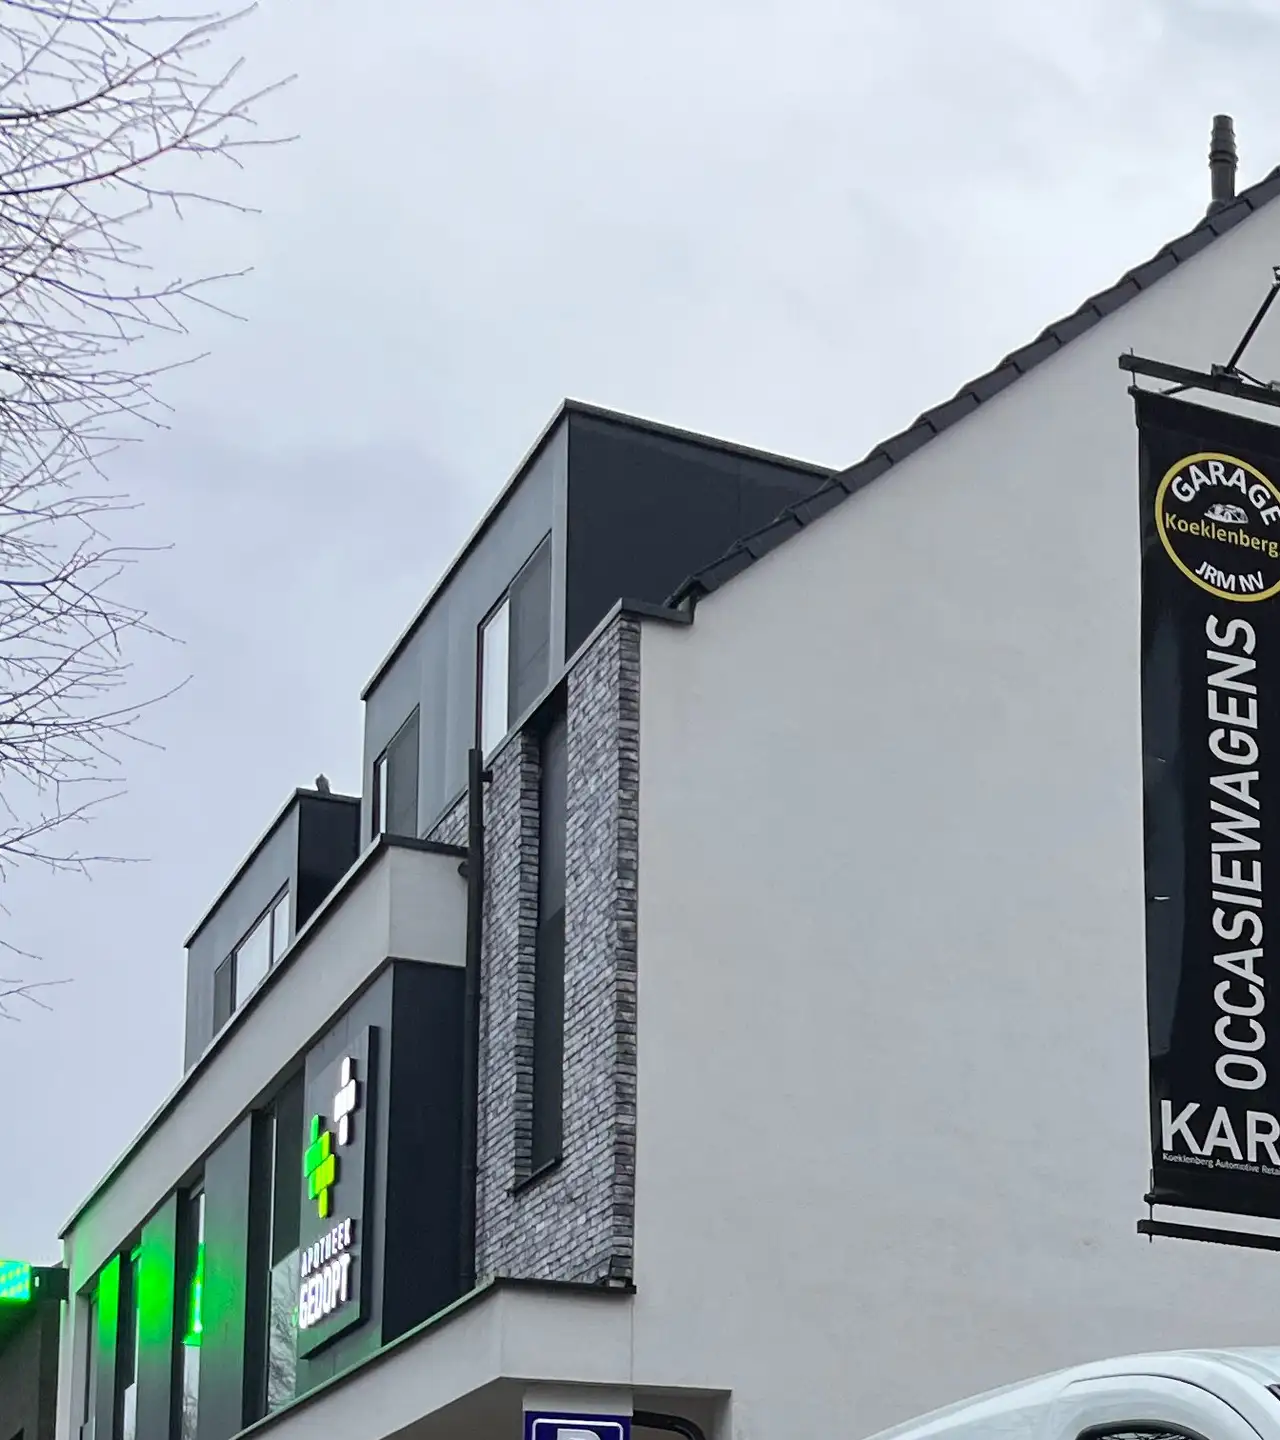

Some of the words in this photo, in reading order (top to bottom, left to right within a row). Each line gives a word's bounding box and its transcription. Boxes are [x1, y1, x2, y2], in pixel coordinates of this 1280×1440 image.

[1195, 561, 1235, 592] JRM
[1239, 571, 1264, 592] NV
[1205, 615, 1267, 1091] OCCASIEWAGENS
[1162, 1153, 1214, 1168] Koeklenberg
[1215, 1158, 1260, 1173] Automotive
[301, 1218, 351, 1277] APOTHEEK
[299, 1253, 351, 1329] GEDOPT
